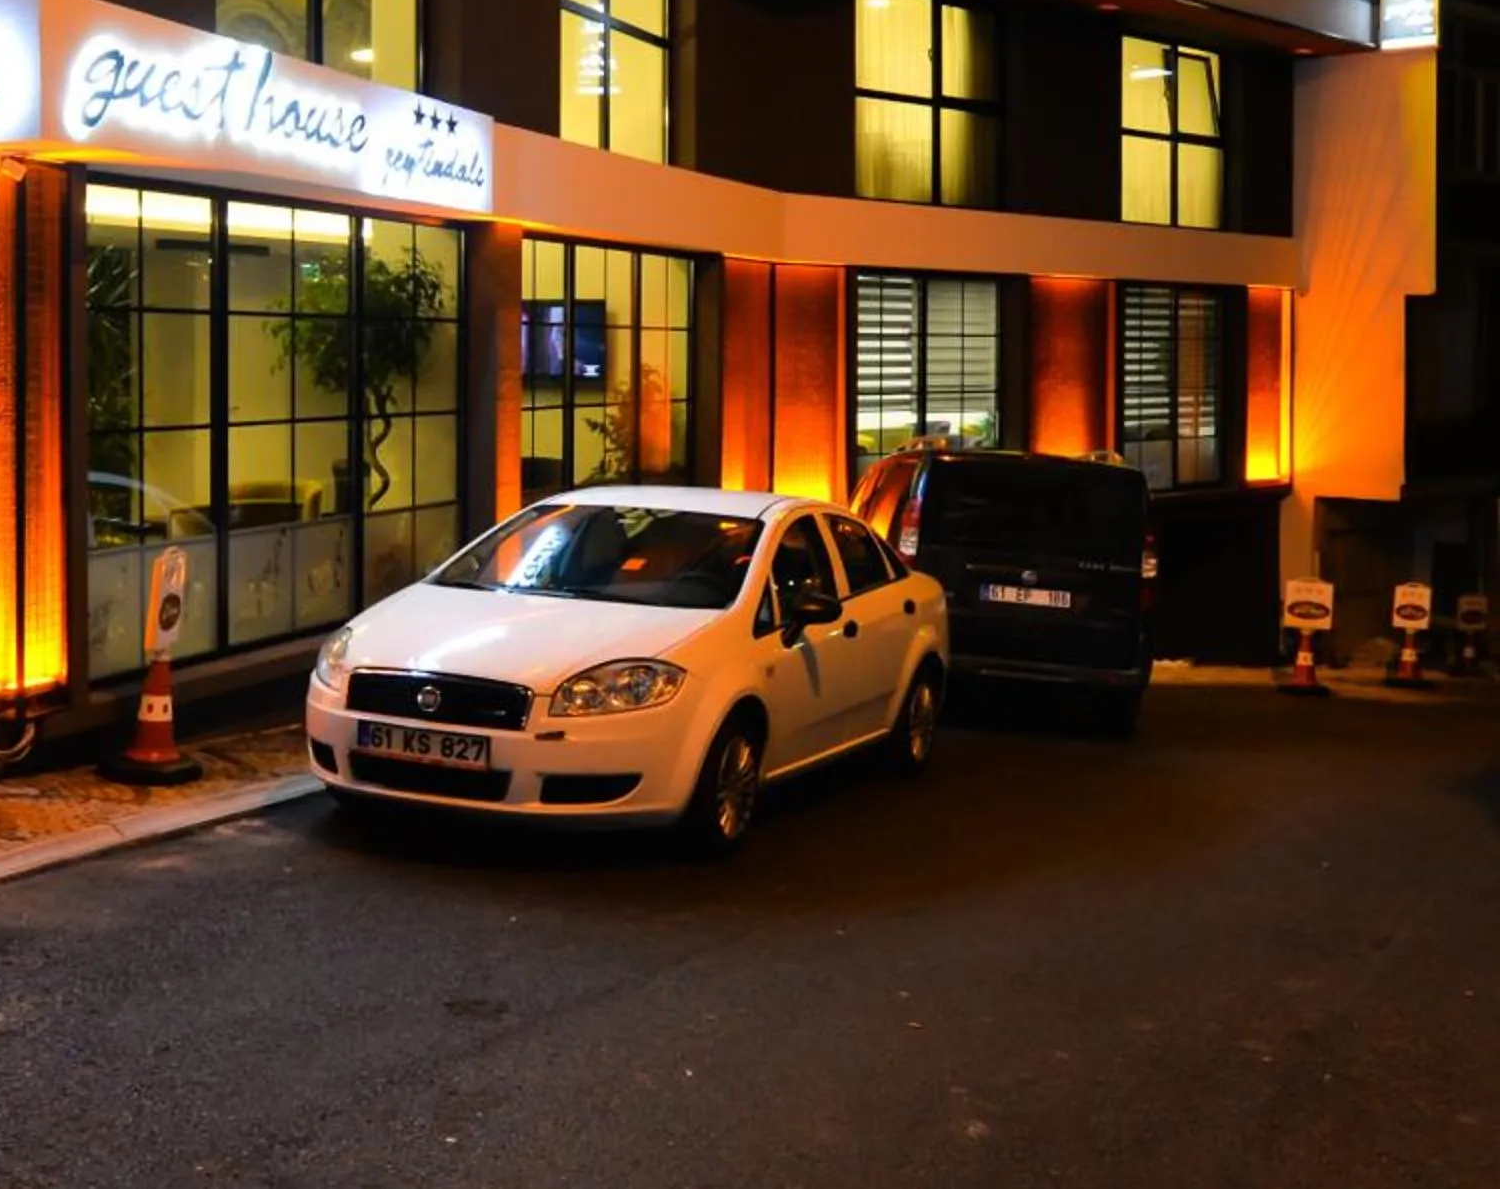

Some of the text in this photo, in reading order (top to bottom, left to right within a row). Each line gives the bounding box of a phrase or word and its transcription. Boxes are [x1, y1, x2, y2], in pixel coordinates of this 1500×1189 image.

[83, 47, 246, 129] guest
[244, 47, 369, 154] house
[371, 726, 484, 762] 61 KS 827
